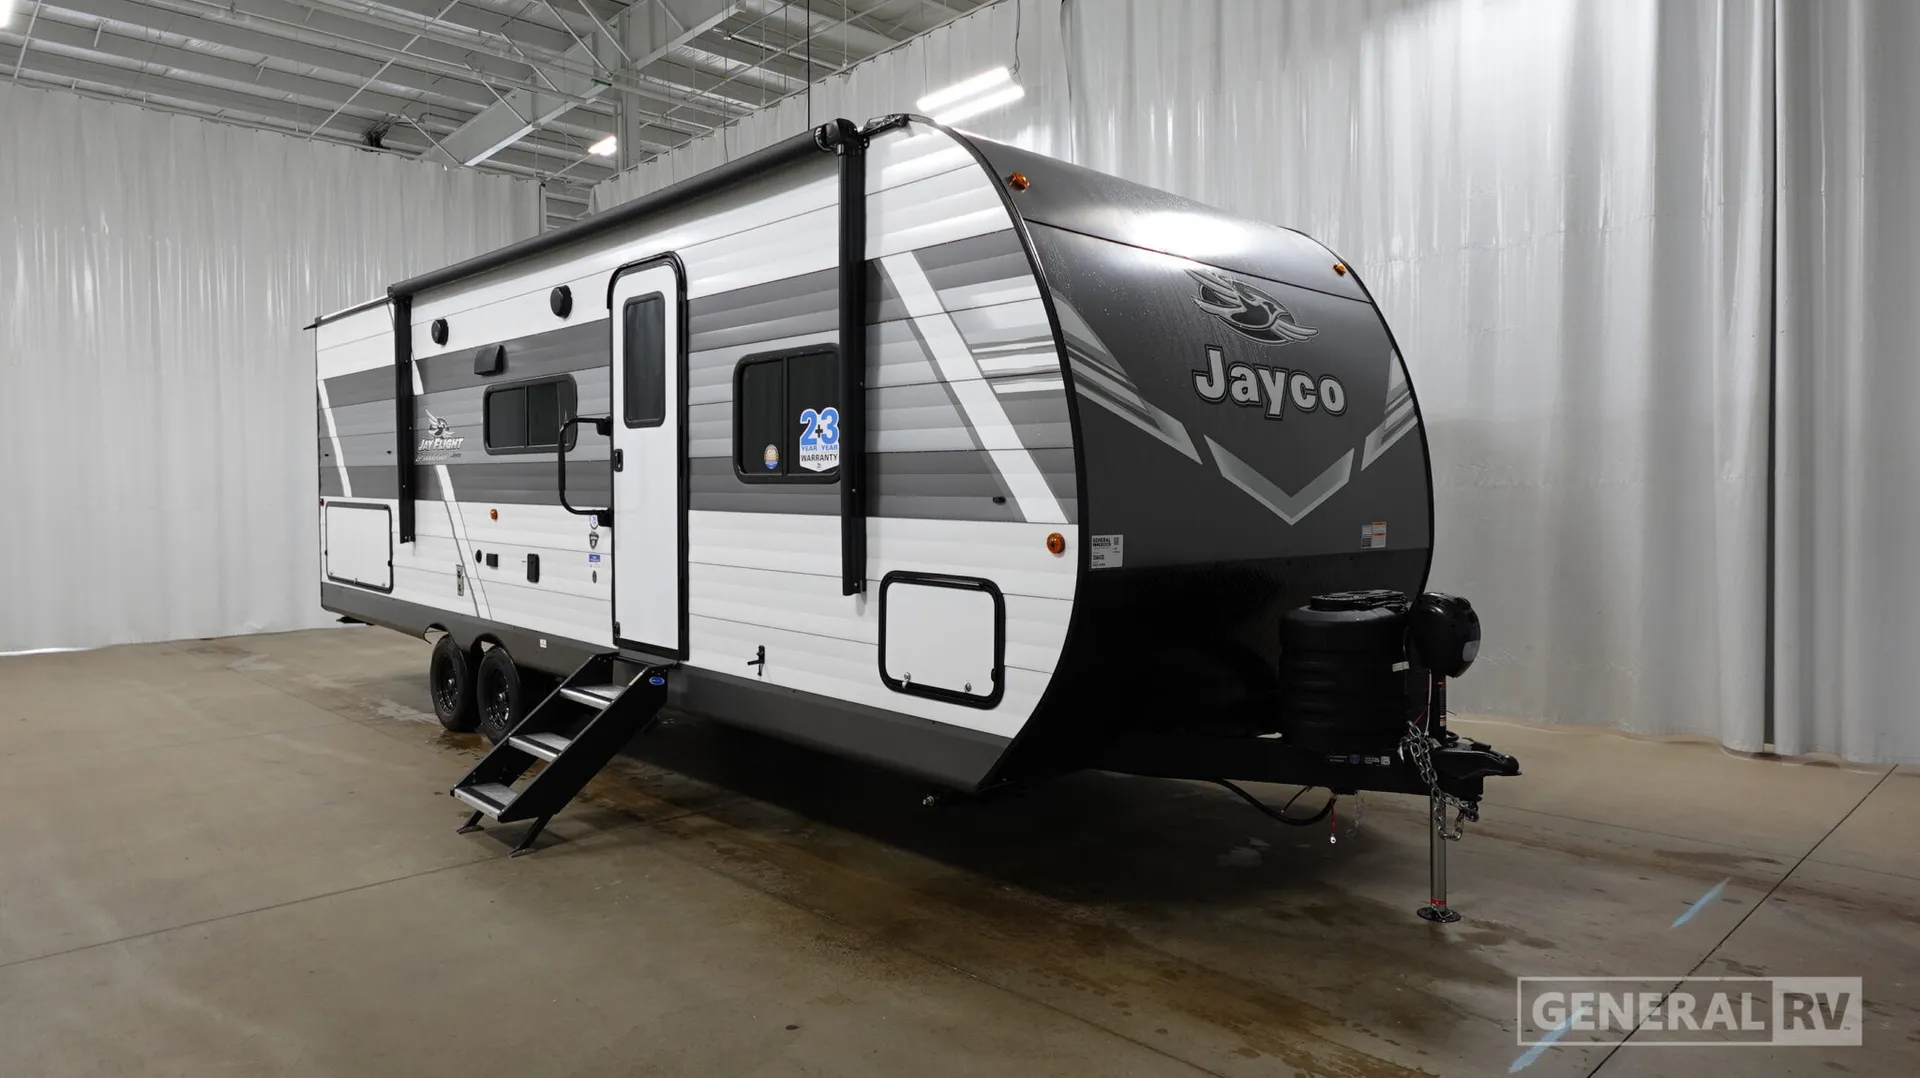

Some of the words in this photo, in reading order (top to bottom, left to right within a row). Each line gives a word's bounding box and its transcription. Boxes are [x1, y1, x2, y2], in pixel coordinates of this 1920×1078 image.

[1192, 344, 1347, 420] Jayco
[418, 439, 434, 451] JAY
[433, 437, 464, 450] FLIGHT
[800, 453, 838, 462] WARRANTY
